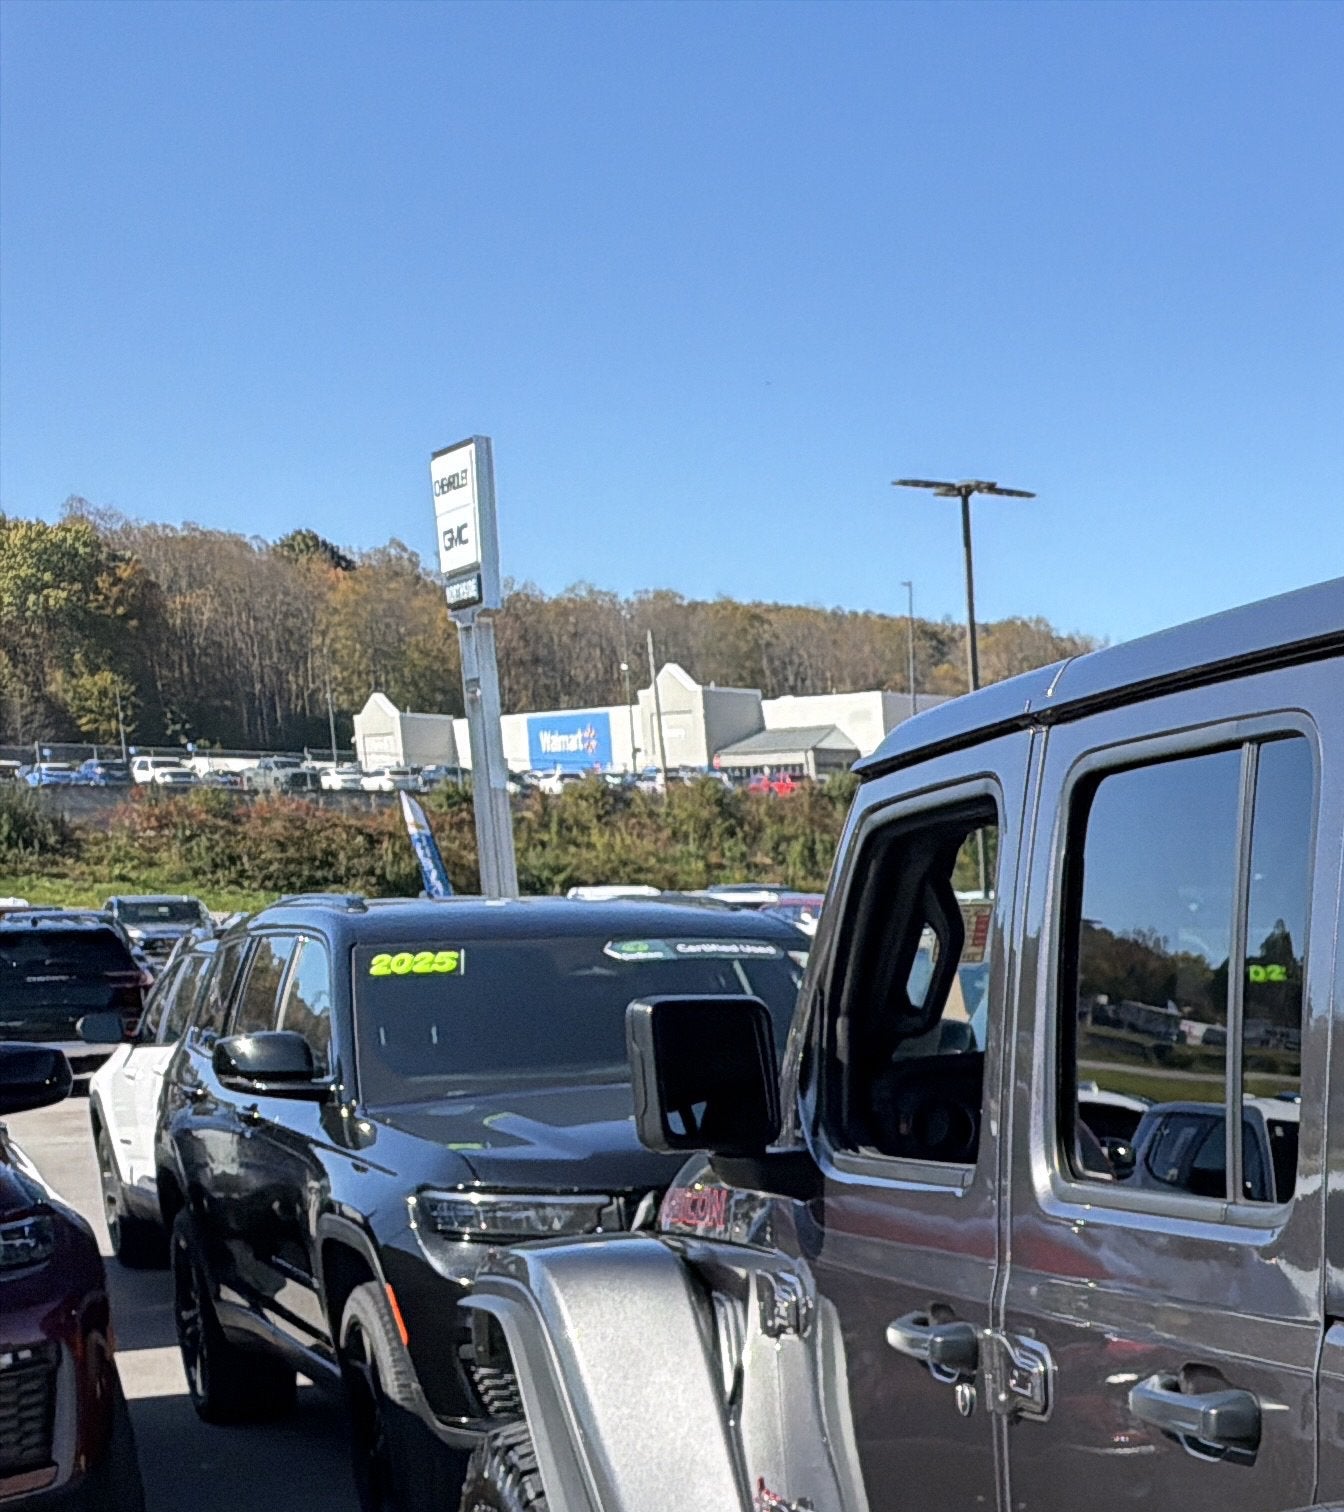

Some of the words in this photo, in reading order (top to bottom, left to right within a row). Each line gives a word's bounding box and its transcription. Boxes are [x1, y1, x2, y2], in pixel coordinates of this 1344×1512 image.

[442, 523, 470, 552] GMC
[538, 729, 584, 753] Walmart
[369, 951, 460, 976] 2025
